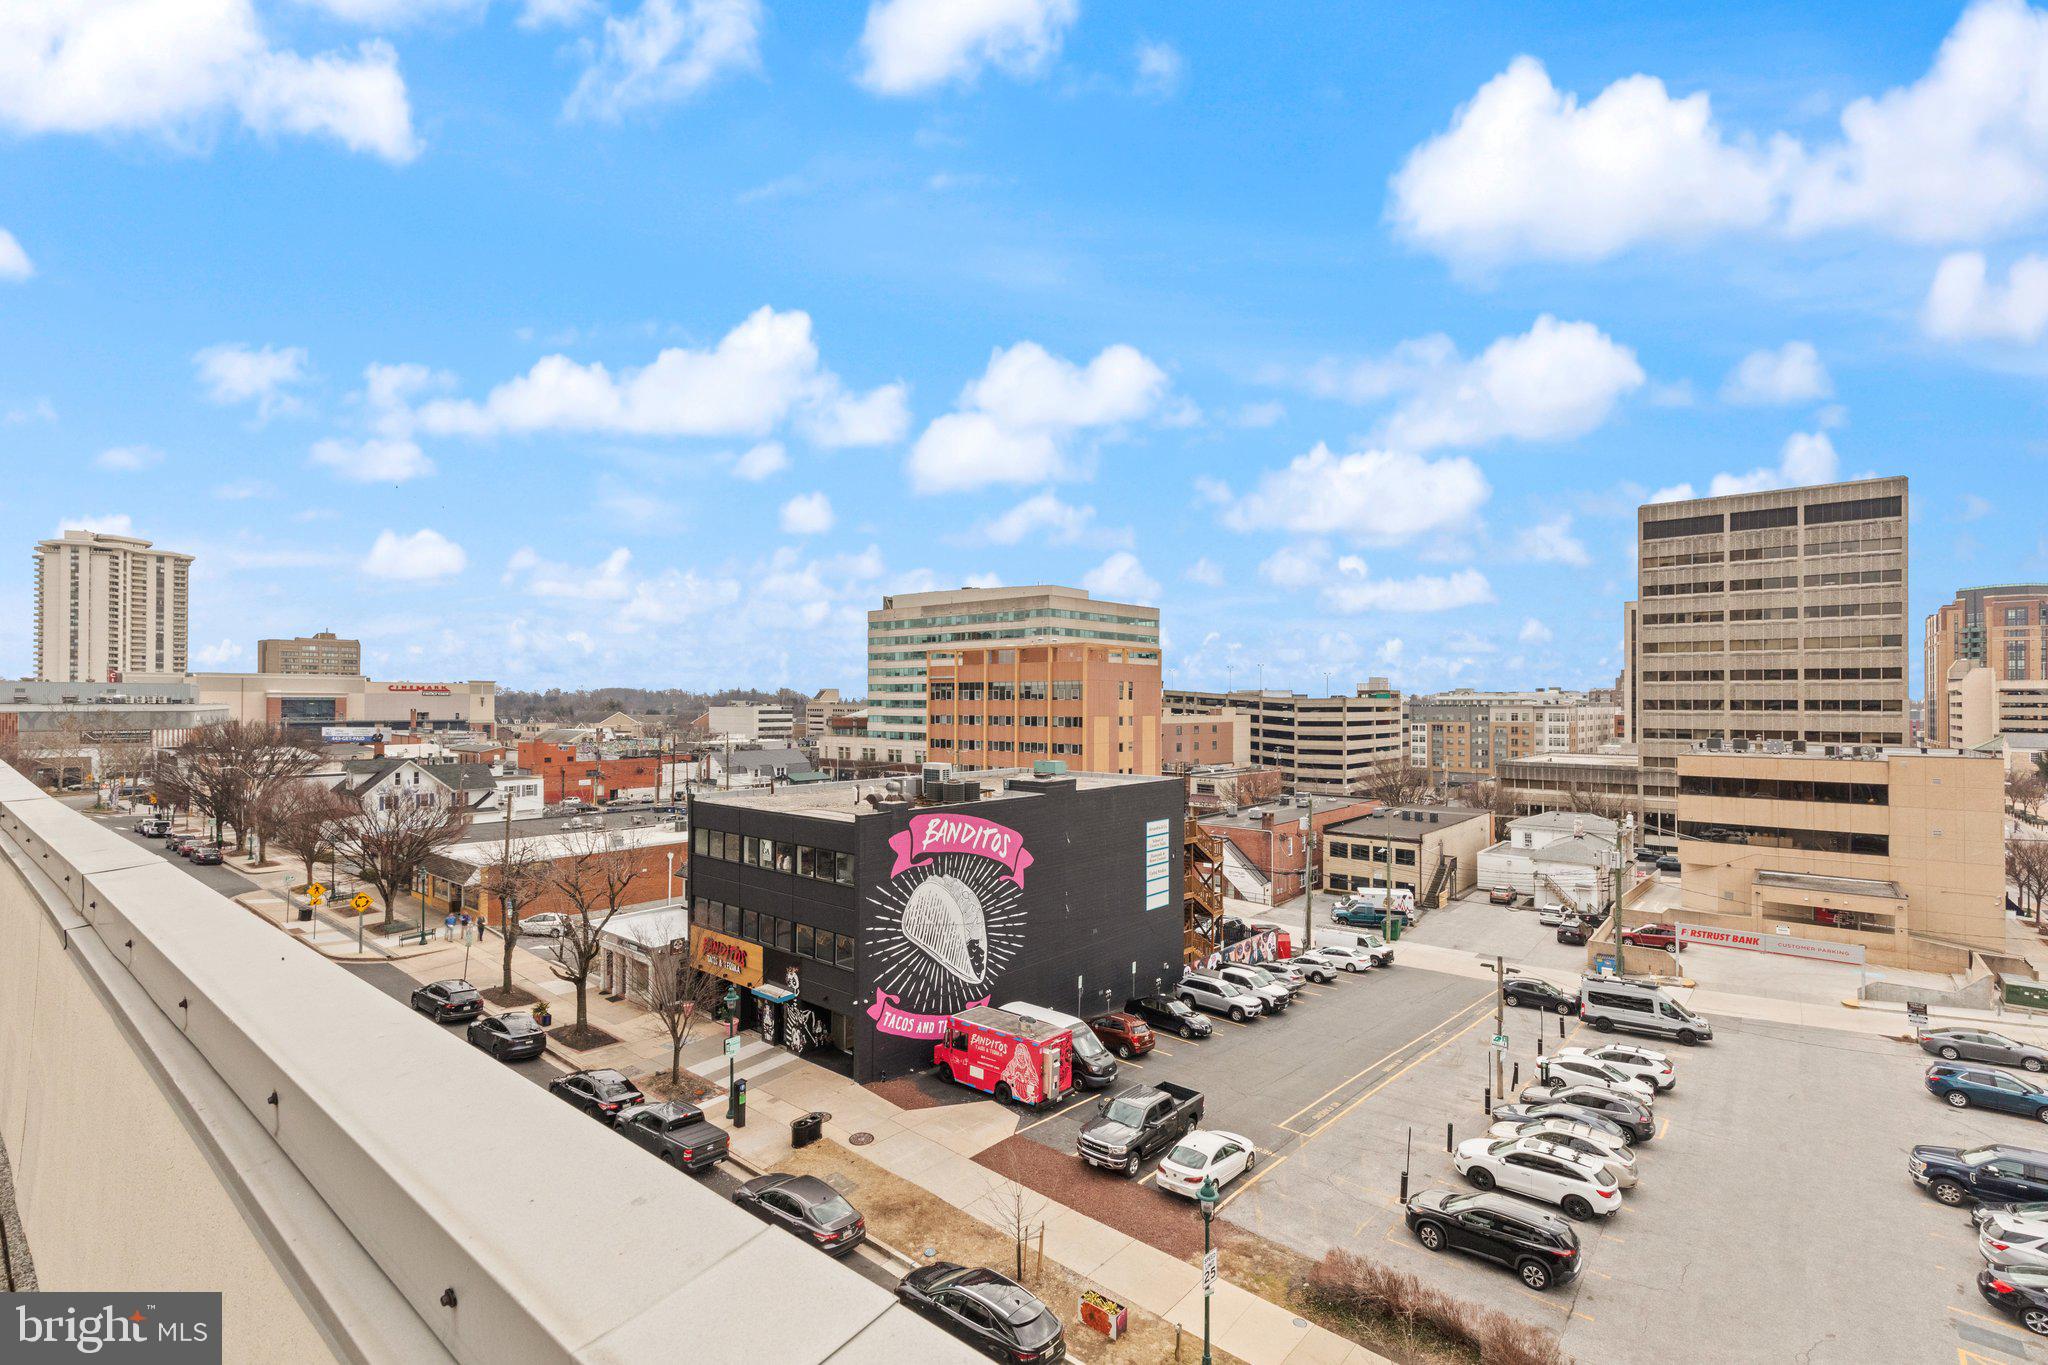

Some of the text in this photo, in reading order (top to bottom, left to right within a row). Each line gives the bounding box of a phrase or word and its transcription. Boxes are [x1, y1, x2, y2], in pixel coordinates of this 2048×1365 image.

[388, 684, 450, 692] CINEMARK
[922, 818, 1011, 858] BANDITOS
[1681, 928, 1760, 945] FRSTRUST BANK
[1777, 942, 1850, 956] CUSTOMER PARKING
[883, 1011, 915, 1033] TACOS
[916, 1020, 935, 1034] AND
[970, 1033, 1009, 1055] BANDITOS
[1204, 1265, 1216, 1284] 25
